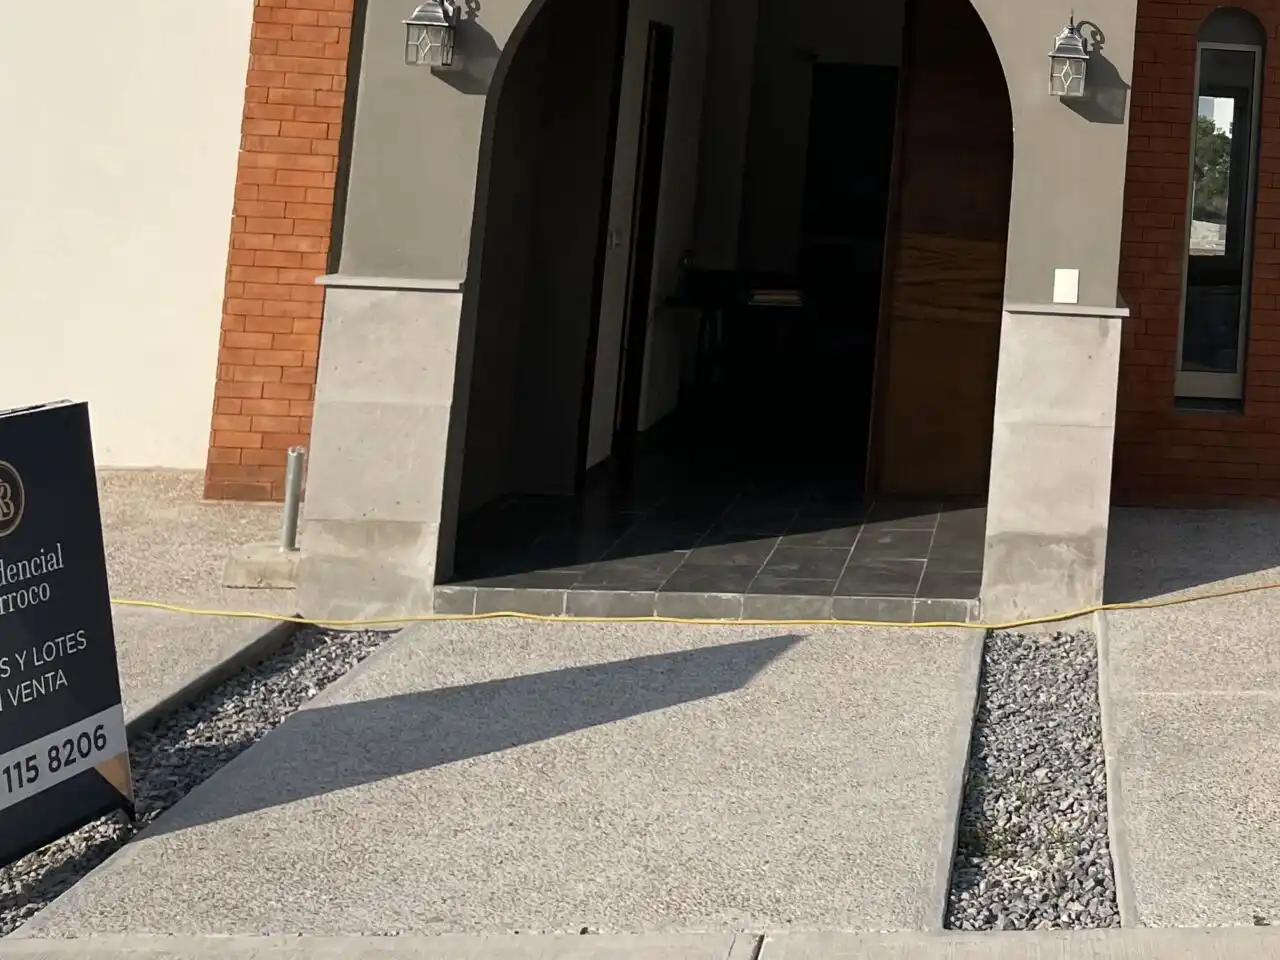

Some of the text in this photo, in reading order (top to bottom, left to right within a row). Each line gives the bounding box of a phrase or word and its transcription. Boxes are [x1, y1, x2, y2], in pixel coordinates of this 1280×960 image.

[15, 650, 27, 671] Y
[32, 629, 87, 666] LOTES
[7, 668, 68, 706] VENTA
[3, 724, 107, 793] 115 8206
